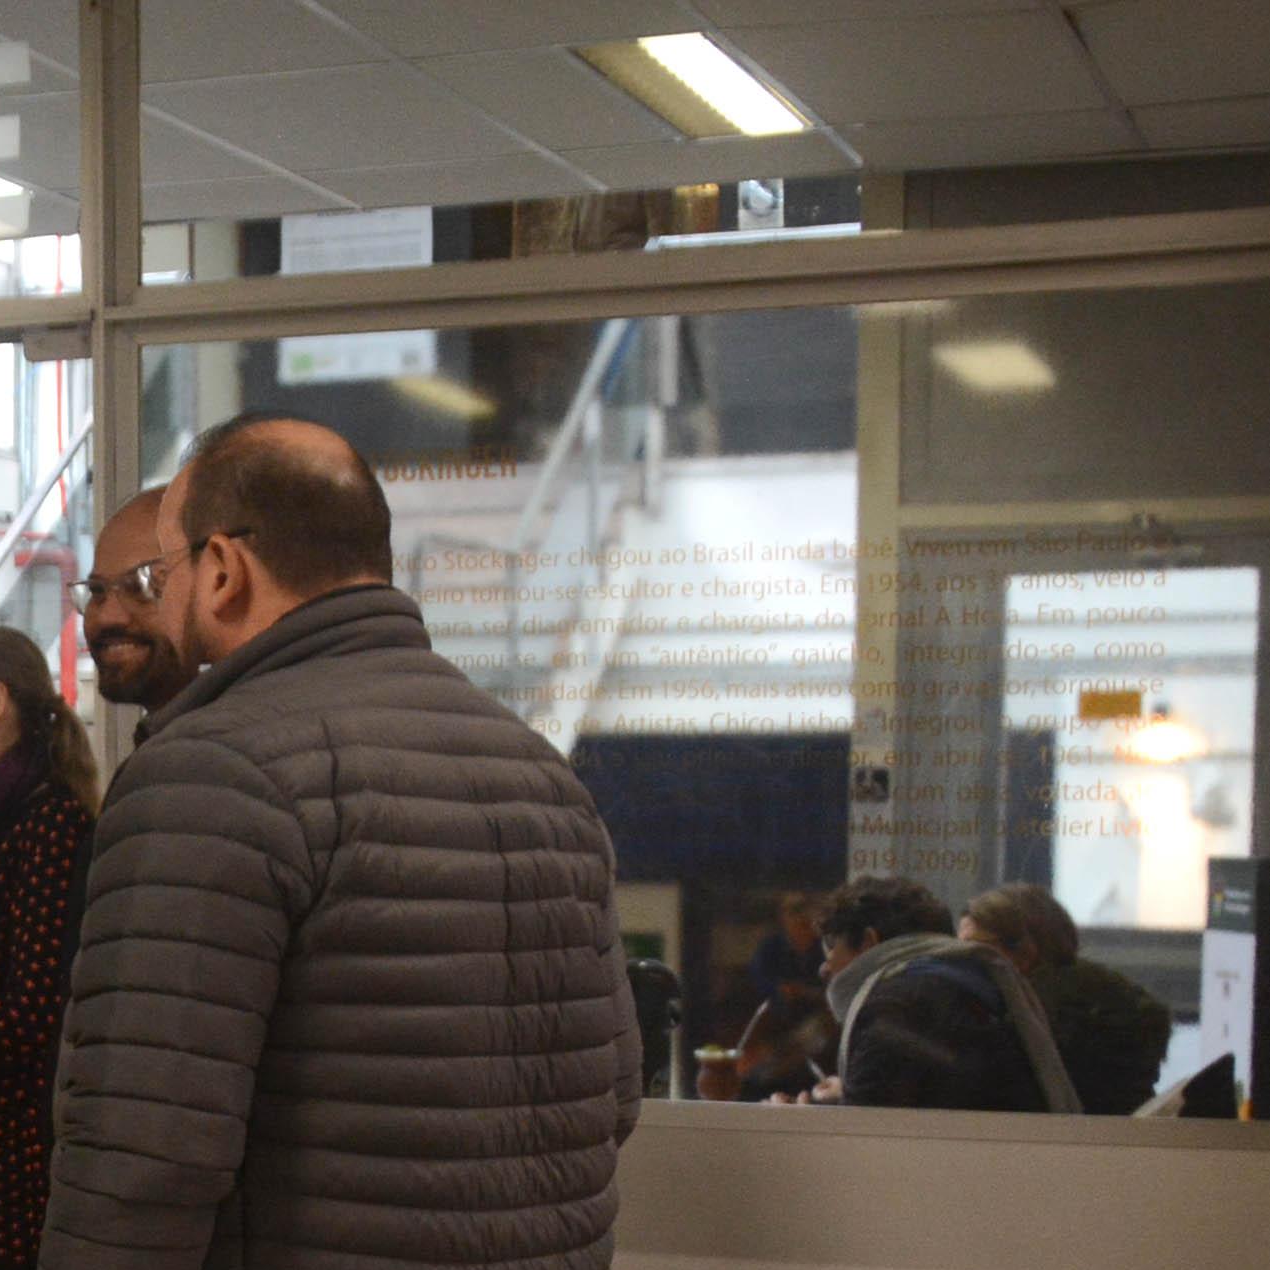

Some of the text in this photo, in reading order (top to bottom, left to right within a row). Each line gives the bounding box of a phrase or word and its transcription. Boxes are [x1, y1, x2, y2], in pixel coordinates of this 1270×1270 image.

[445, 549, 559, 574] Stockinger
[568, 546, 652, 570] chegou
[661, 549, 686, 564] ao
[693, 540, 754, 564] Brasil
[761, 540, 826, 561] ainda
[584, 577, 674, 600] escultor
[681, 582, 694, 598] e
[701, 576, 813, 600] chargista.
[821, 574, 855, 595] Em
[937, 574, 977, 591] aos
[1020, 571, 1085, 592] anos,
[1093, 568, 1148, 589] veio
[1152, 570, 1167, 588] a
[522, 612, 670, 638] diagramador
[677, 613, 690, 629] e
[699, 607, 806, 634] chargista
[814, 608, 847, 630] do
[1036, 602, 1075, 624] Em
[1086, 605, 1167, 629] pouco
[1093, 640, 1166, 660] como
[619, 679, 653, 700] Em
[663, 678, 720, 702] 1956,
[725, 678, 780, 699] mais
[785, 677, 843, 698] ativo
[850, 679, 917, 697] como
[1043, 675, 1165, 696] tornou-se
[709, 710, 776, 731] Chico
